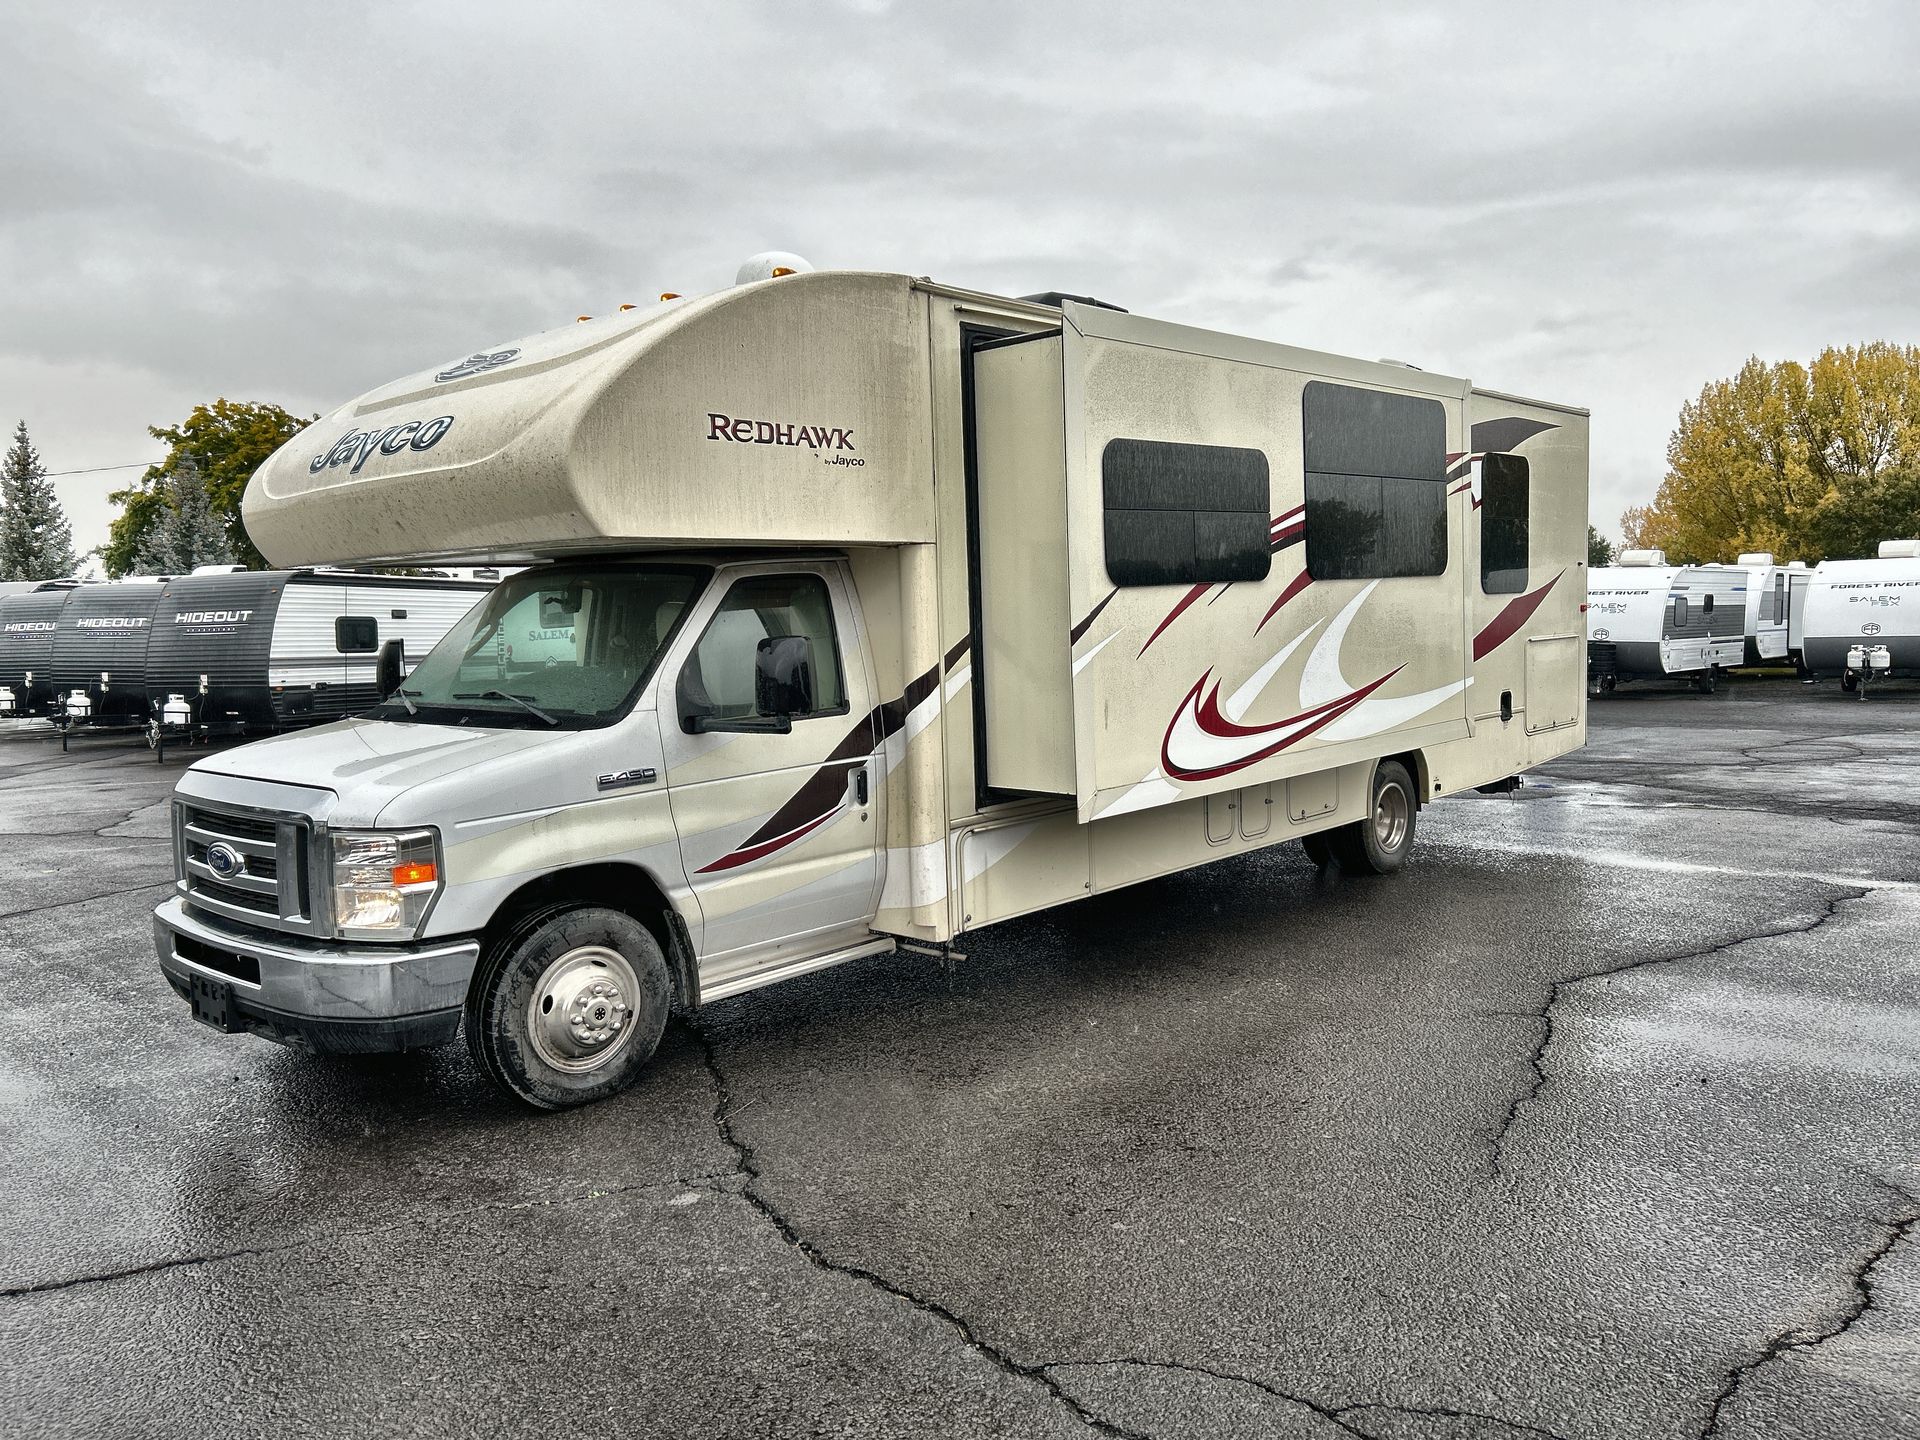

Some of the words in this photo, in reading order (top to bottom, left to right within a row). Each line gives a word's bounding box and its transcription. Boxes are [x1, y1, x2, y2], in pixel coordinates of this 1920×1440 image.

[308, 415, 455, 474] Jayco
[824, 458, 832, 466] by
[832, 454, 865, 468] Jayco
[1848, 595, 1901, 603] SALEM
[76, 617, 148, 628] HIDEOUT
[174, 610, 253, 624] HIDEOUT
[4, 621, 57, 632] HIDEOU
[528, 629, 569, 642] SALEM
